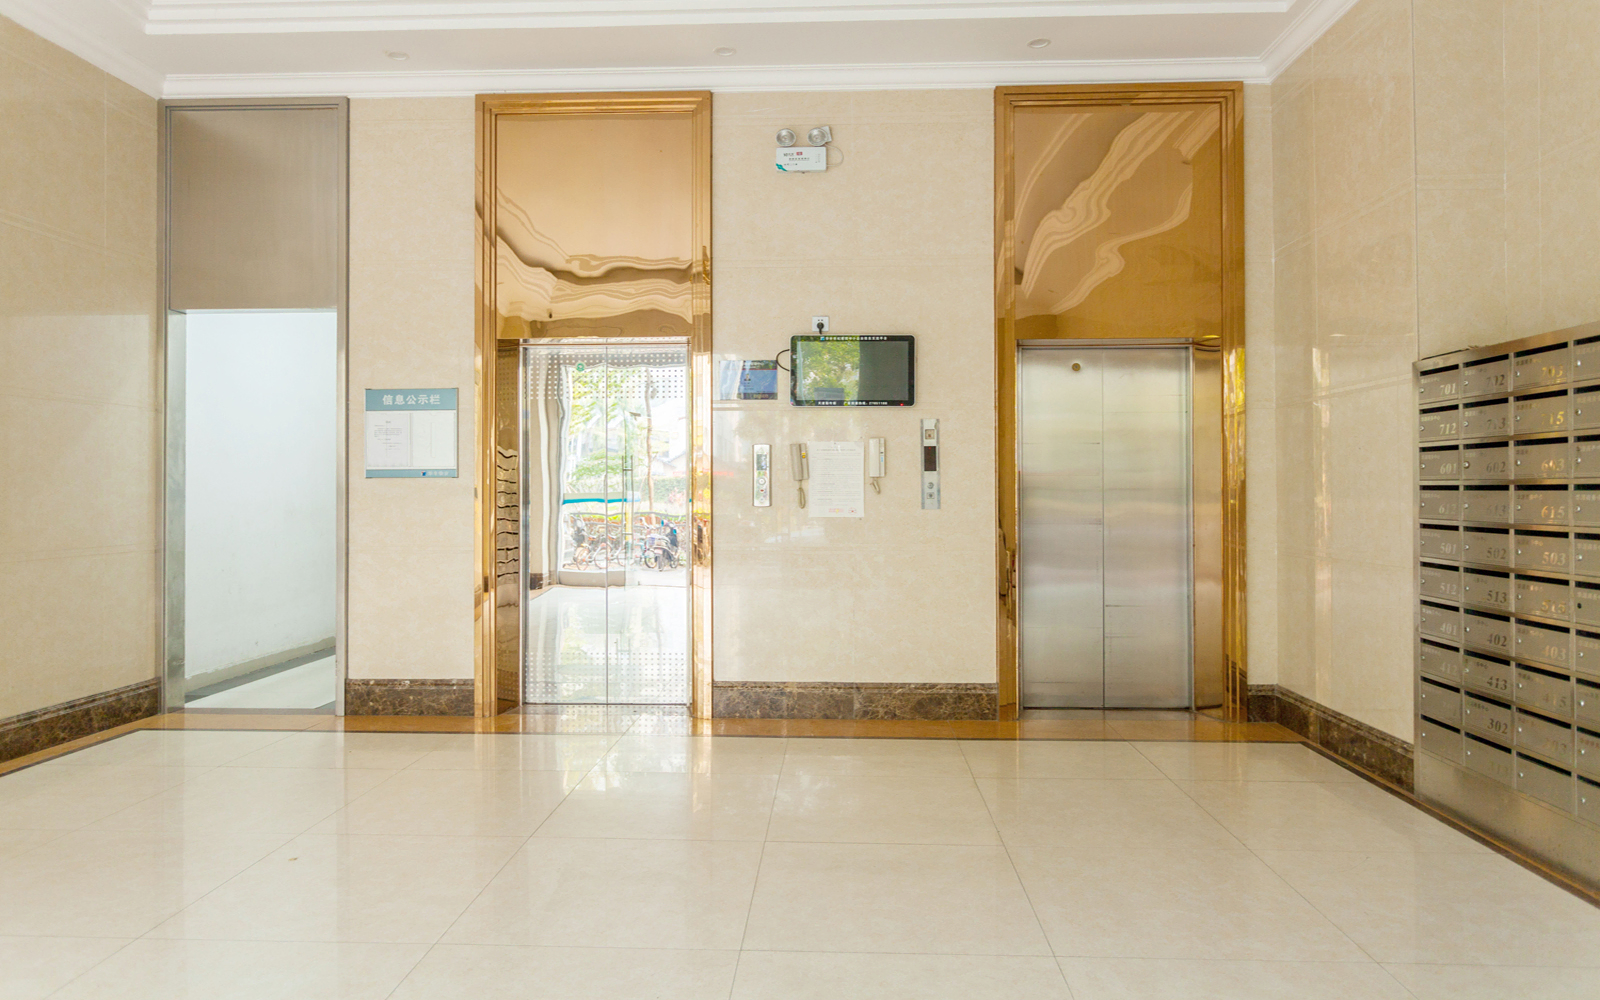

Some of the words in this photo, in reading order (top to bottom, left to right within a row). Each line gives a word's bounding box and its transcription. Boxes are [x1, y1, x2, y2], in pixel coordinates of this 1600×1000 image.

[1541, 364, 1564, 377] 703
[1486, 374, 1505, 387] 702
[1439, 382, 1456, 396] 701
[382, 394, 441, 405] 信息公示栏
[1439, 422, 1457, 435] 712
[1440, 462, 1456, 474] 601
[1486, 461, 1506, 473] 602
[1541, 505, 1565, 519] 615
[1440, 542, 1456, 554] 501
[1486, 547, 1506, 560] 502
[1542, 551, 1566, 566] 503
[1440, 582, 1457, 595] 512
[1486, 590, 1507, 604] 513
[1541, 599, 1566, 614] 515
[1440, 622, 1457, 636] 401
[1487, 633, 1507, 647] 402
[1543, 645, 1566, 661] 403
[1487, 676, 1507, 691] 413
[1487, 718, 1508, 735] 302
